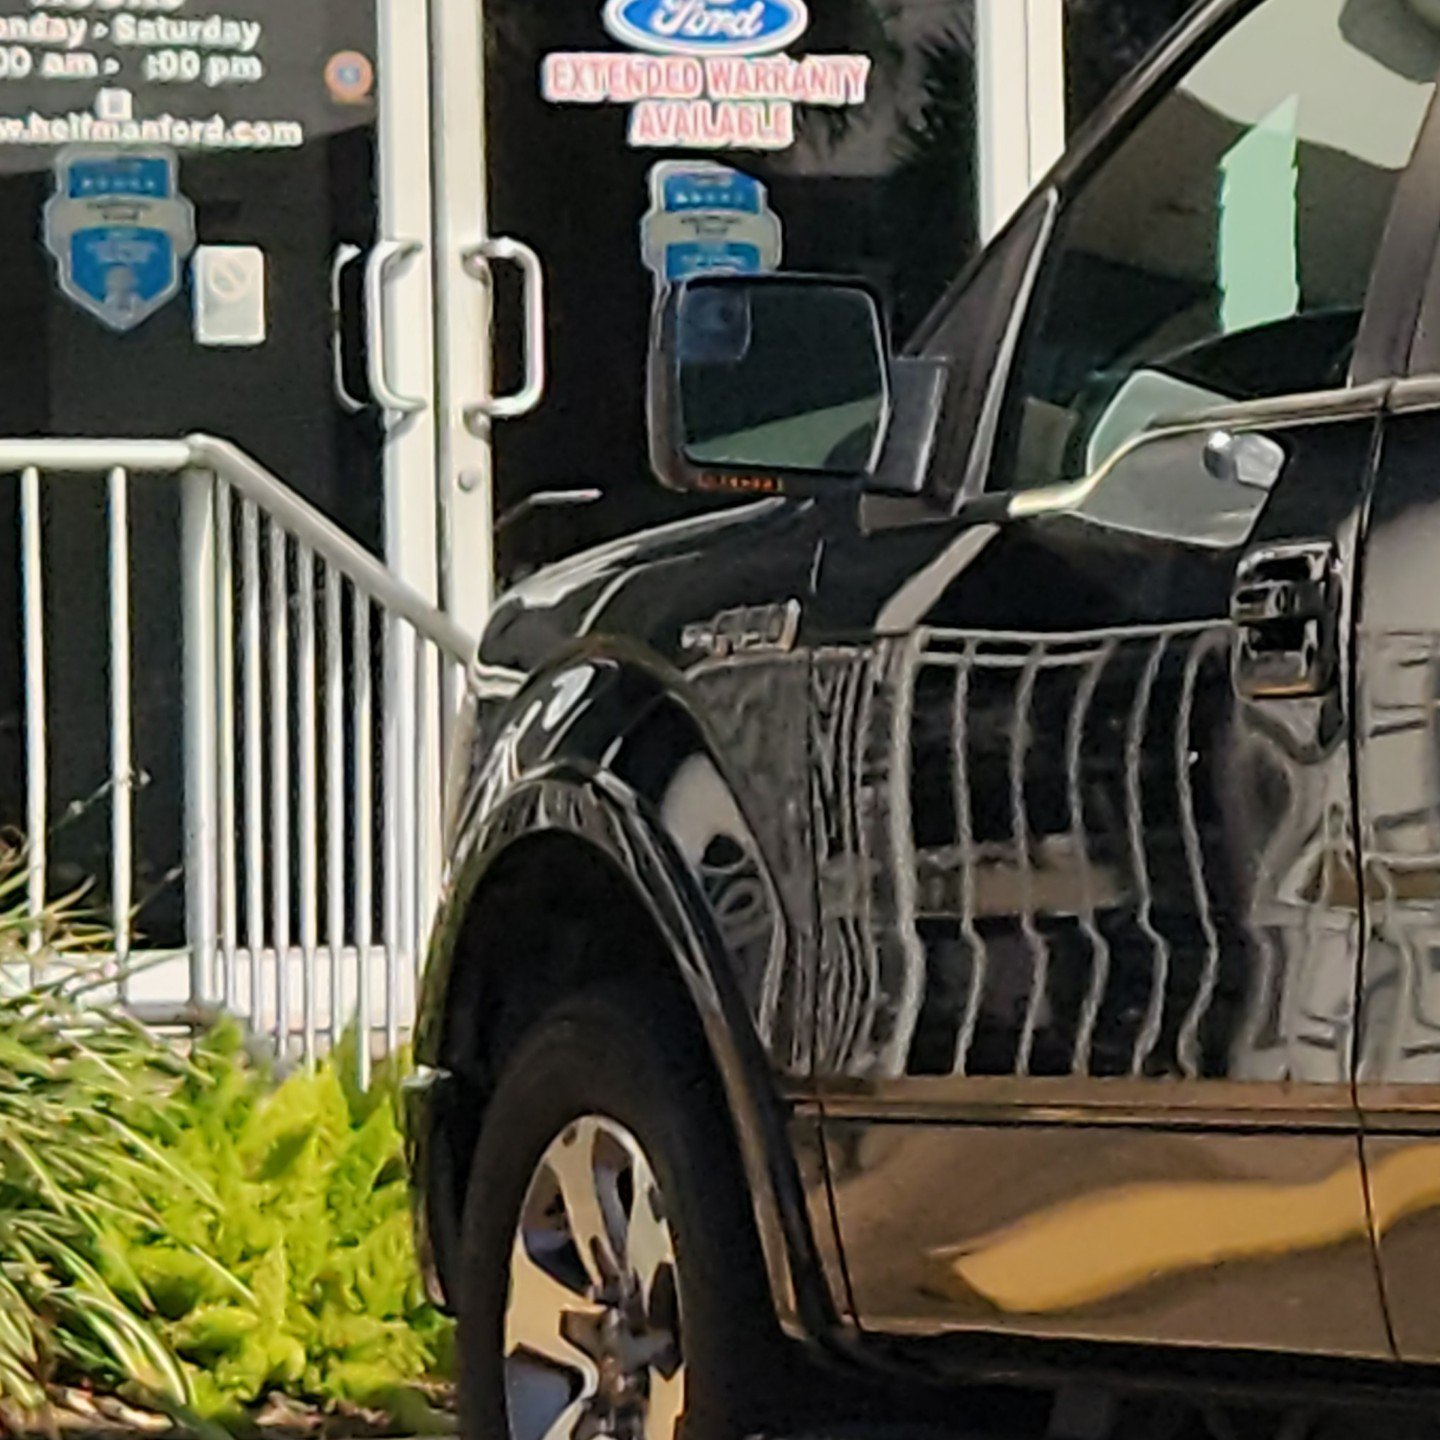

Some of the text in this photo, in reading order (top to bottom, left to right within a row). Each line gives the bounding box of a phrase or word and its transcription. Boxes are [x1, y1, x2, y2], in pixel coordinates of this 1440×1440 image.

[0, 12, 261, 51] nday Saturday
[0, 47, 32, 79] 0
[41, 52, 98, 78] am
[203, 55, 263, 87] pm
[551, 60, 867, 96] EXTENDED WARRANTY
[0, 112, 303, 148] w.helfmanford.com
